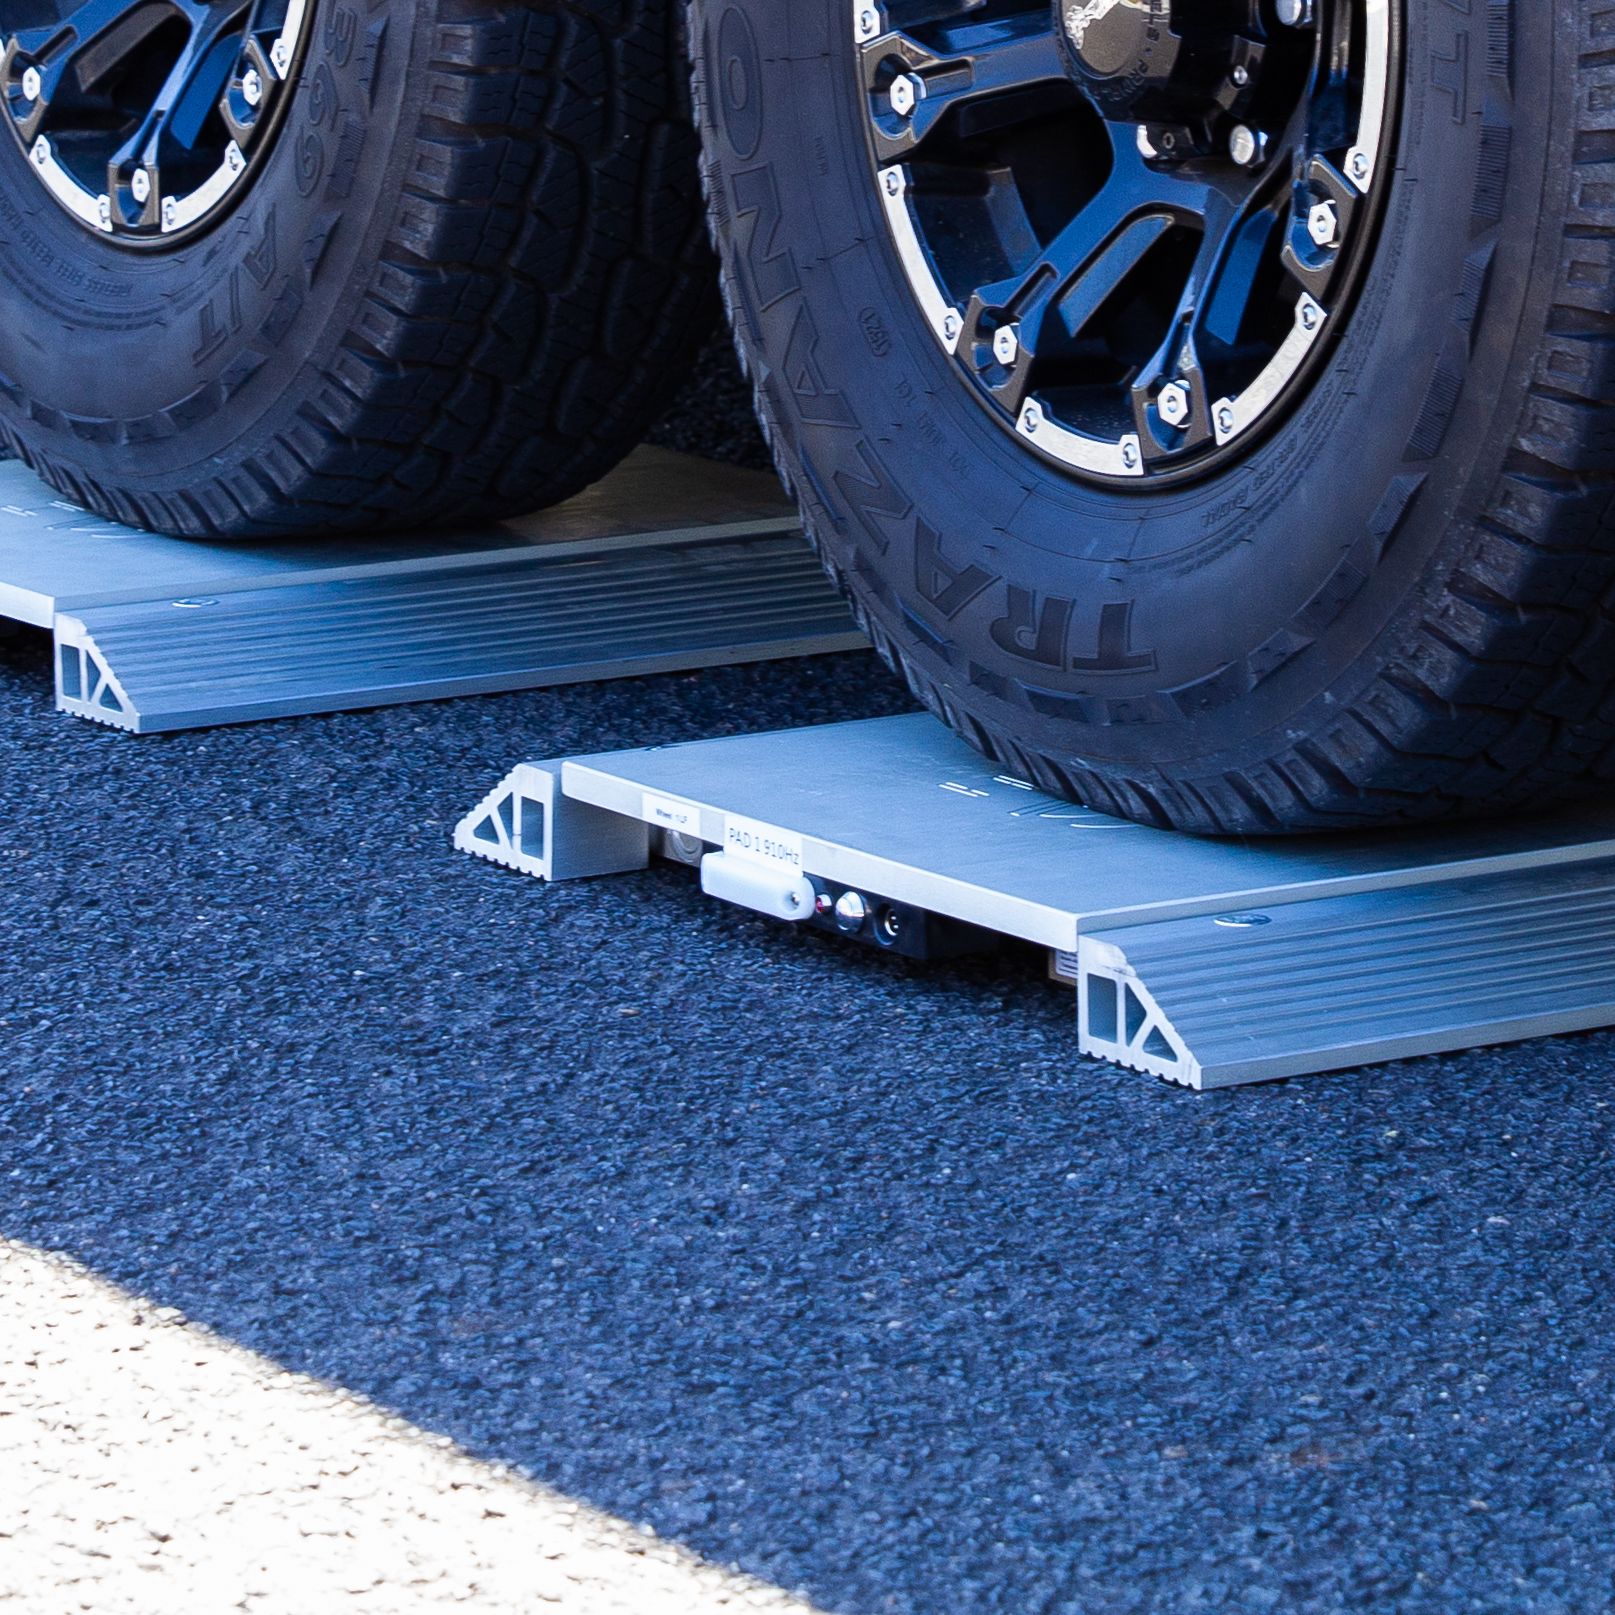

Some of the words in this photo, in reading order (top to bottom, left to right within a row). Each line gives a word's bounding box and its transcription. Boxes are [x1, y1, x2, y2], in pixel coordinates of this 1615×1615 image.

[192, 208, 282, 357] A/T
[715, 4, 1158, 676] TRAZANO
[729, 827, 753, 849] PAD
[754, 835, 762, 854] 1
[763, 838, 801, 866] 910Hz
